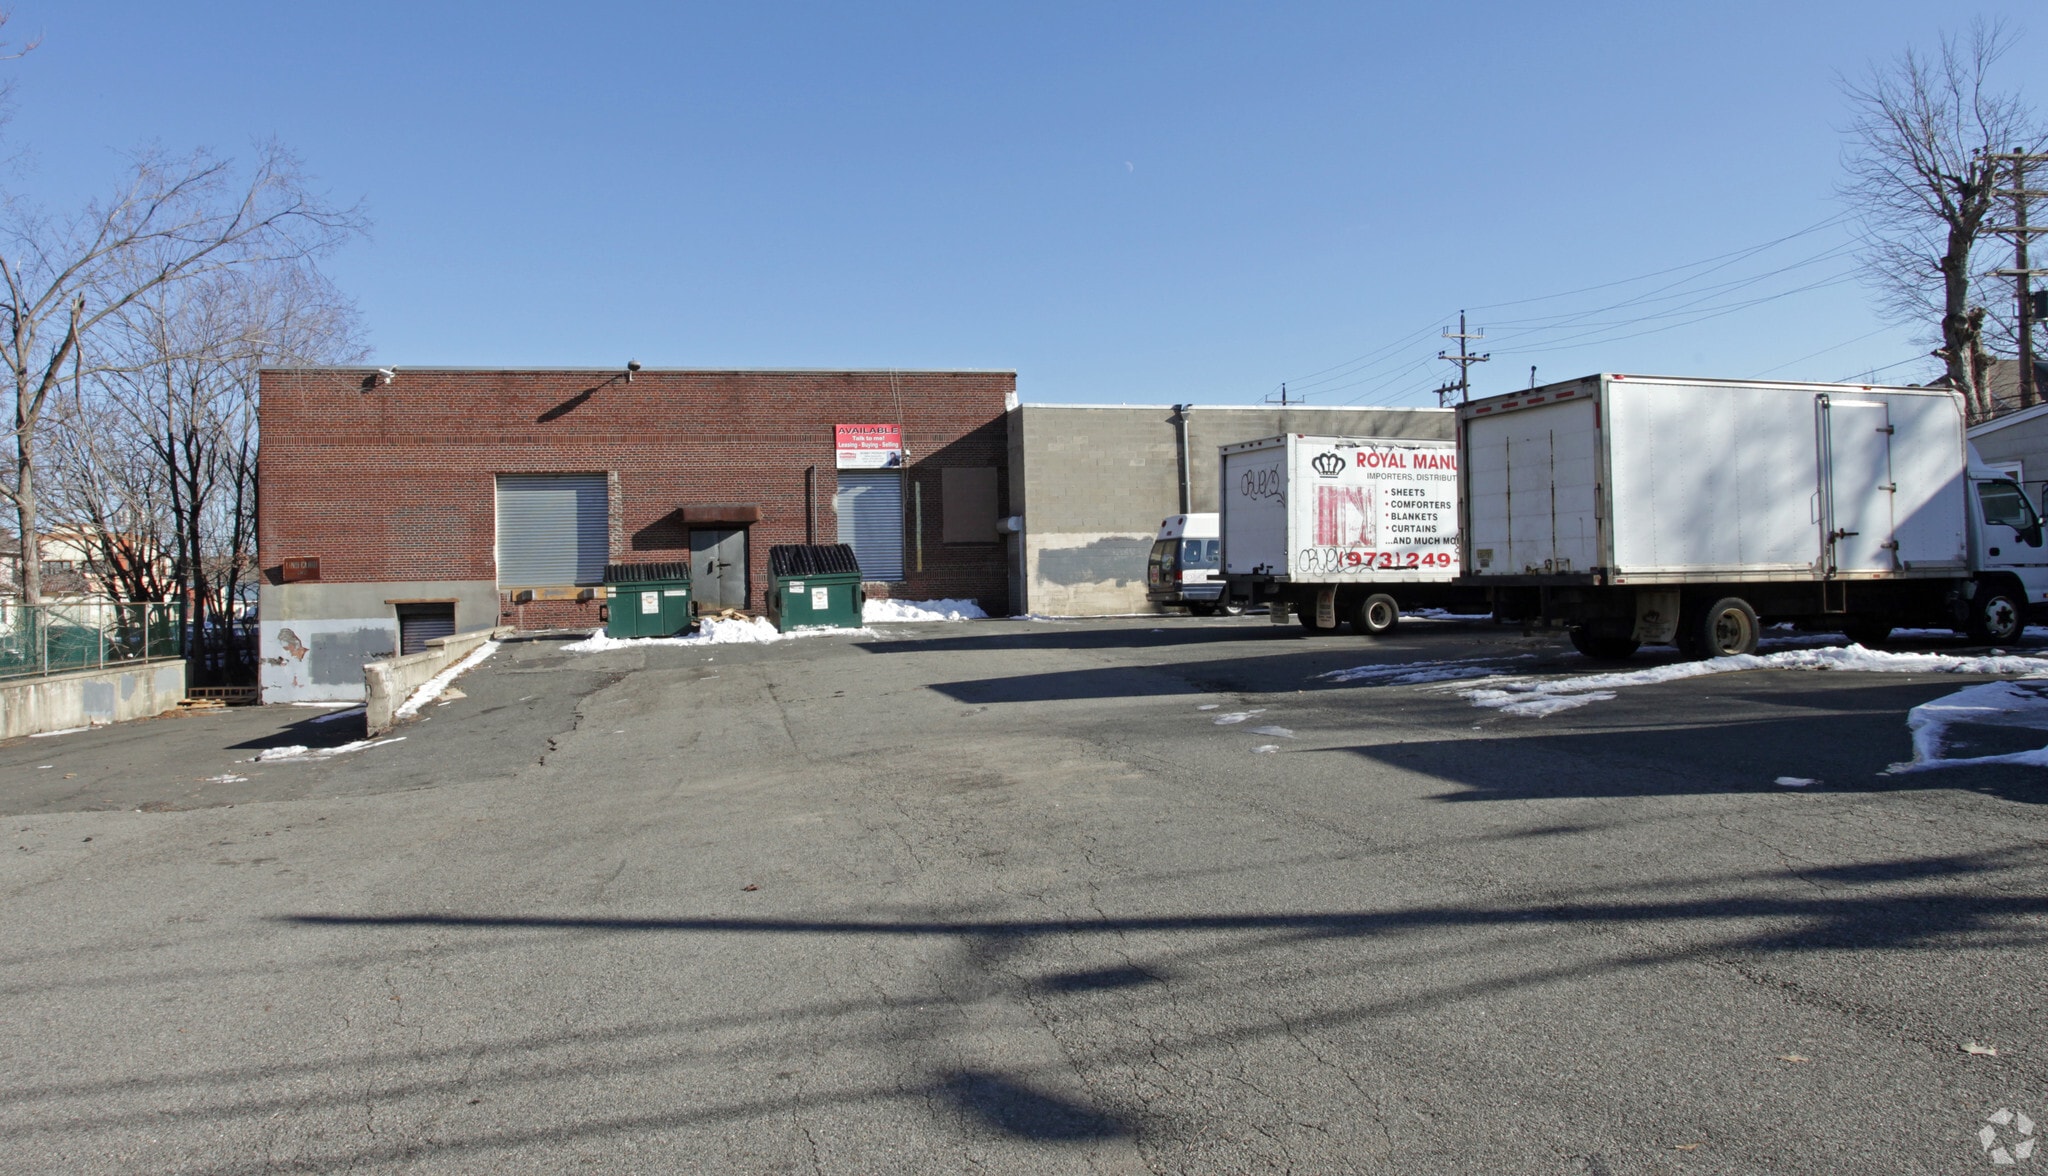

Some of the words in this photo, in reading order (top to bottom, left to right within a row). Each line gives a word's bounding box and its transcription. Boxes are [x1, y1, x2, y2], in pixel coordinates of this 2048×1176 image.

[1356, 452, 1407, 469] ROYAL
[1367, 472, 1415, 482] IMPORTERS,
[1391, 488, 1425, 497] SHEETS
[1391, 500, 1452, 510] COMFORTERS
[1391, 513, 1438, 521] BLANKETS
[1391, 525, 1437, 533] CURTAINS
[1414, 536, 1441, 545] MUCH
